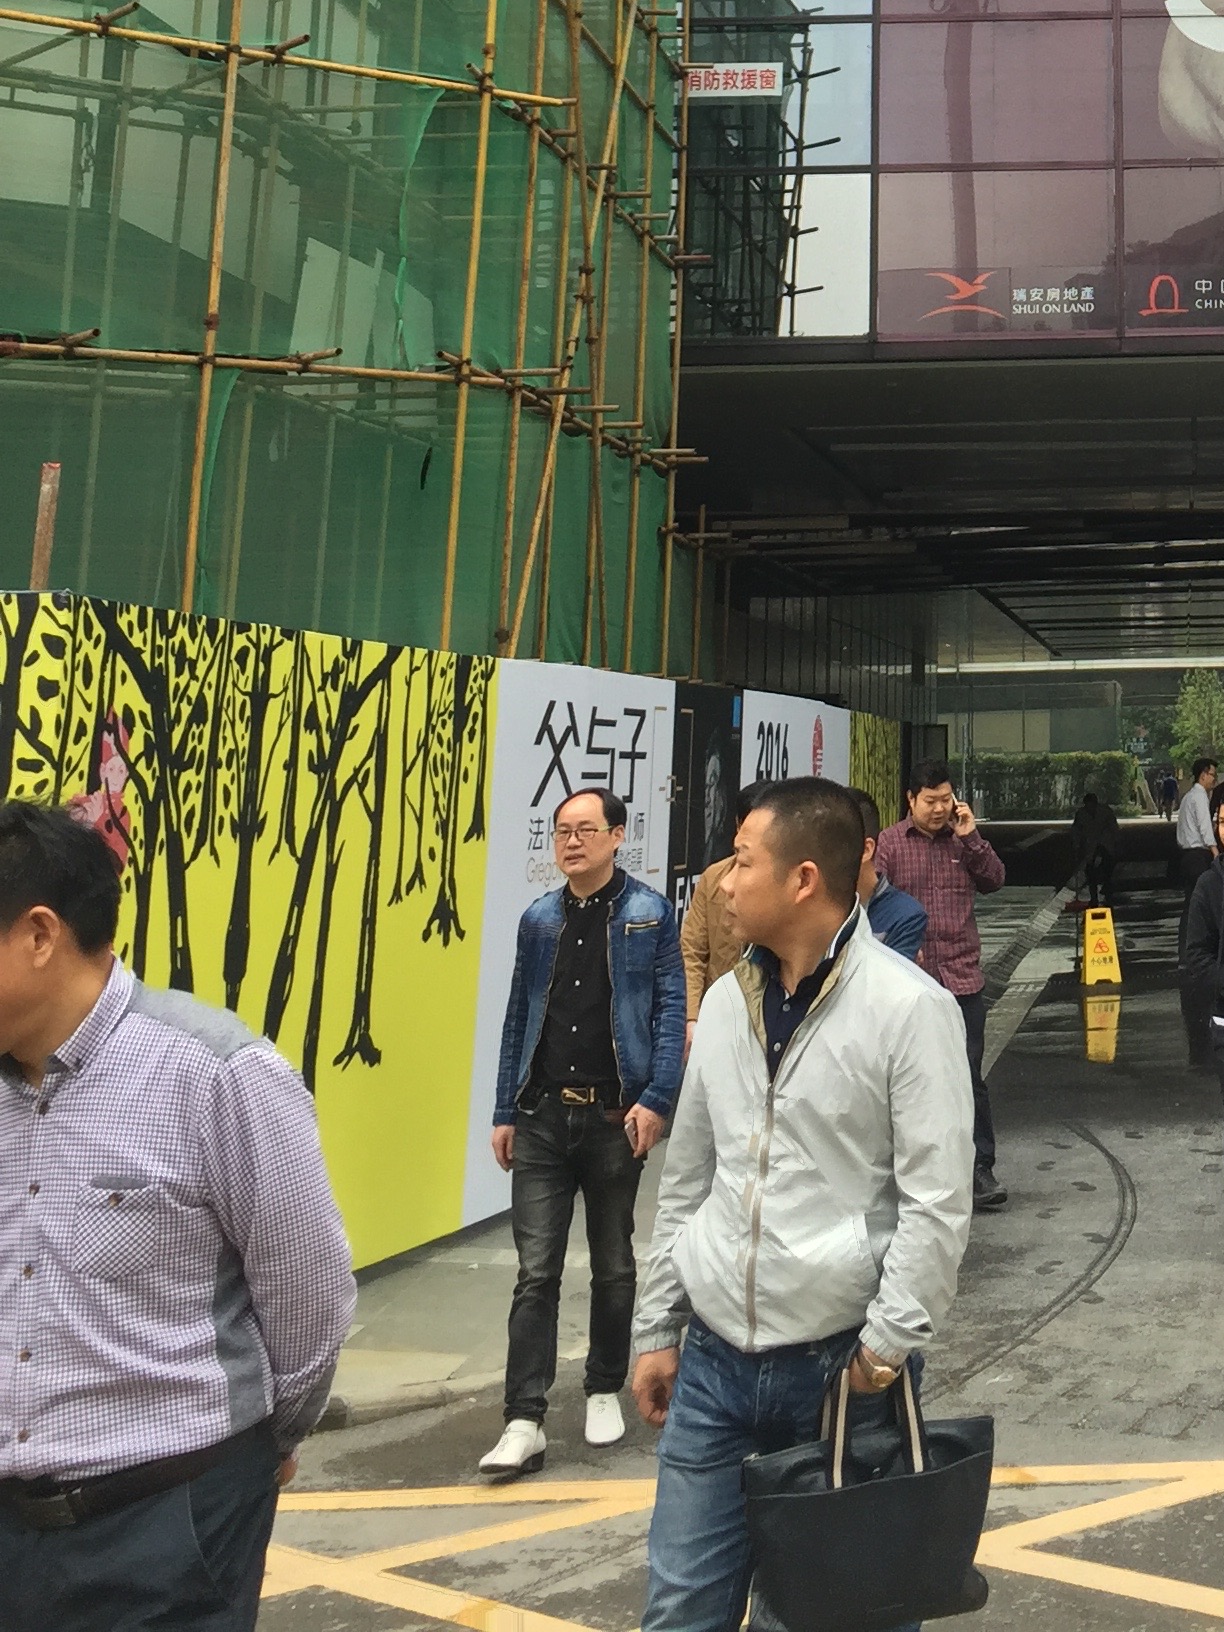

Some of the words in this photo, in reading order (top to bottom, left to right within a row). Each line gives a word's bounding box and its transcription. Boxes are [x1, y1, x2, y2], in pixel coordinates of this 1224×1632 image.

[1012, 303, 1040, 315] SHUI
[1042, 303, 1061, 314] ON
[1063, 302, 1095, 314] LAND
[529, 699, 648, 808] 父与子
[755, 720, 789, 781] 2016
